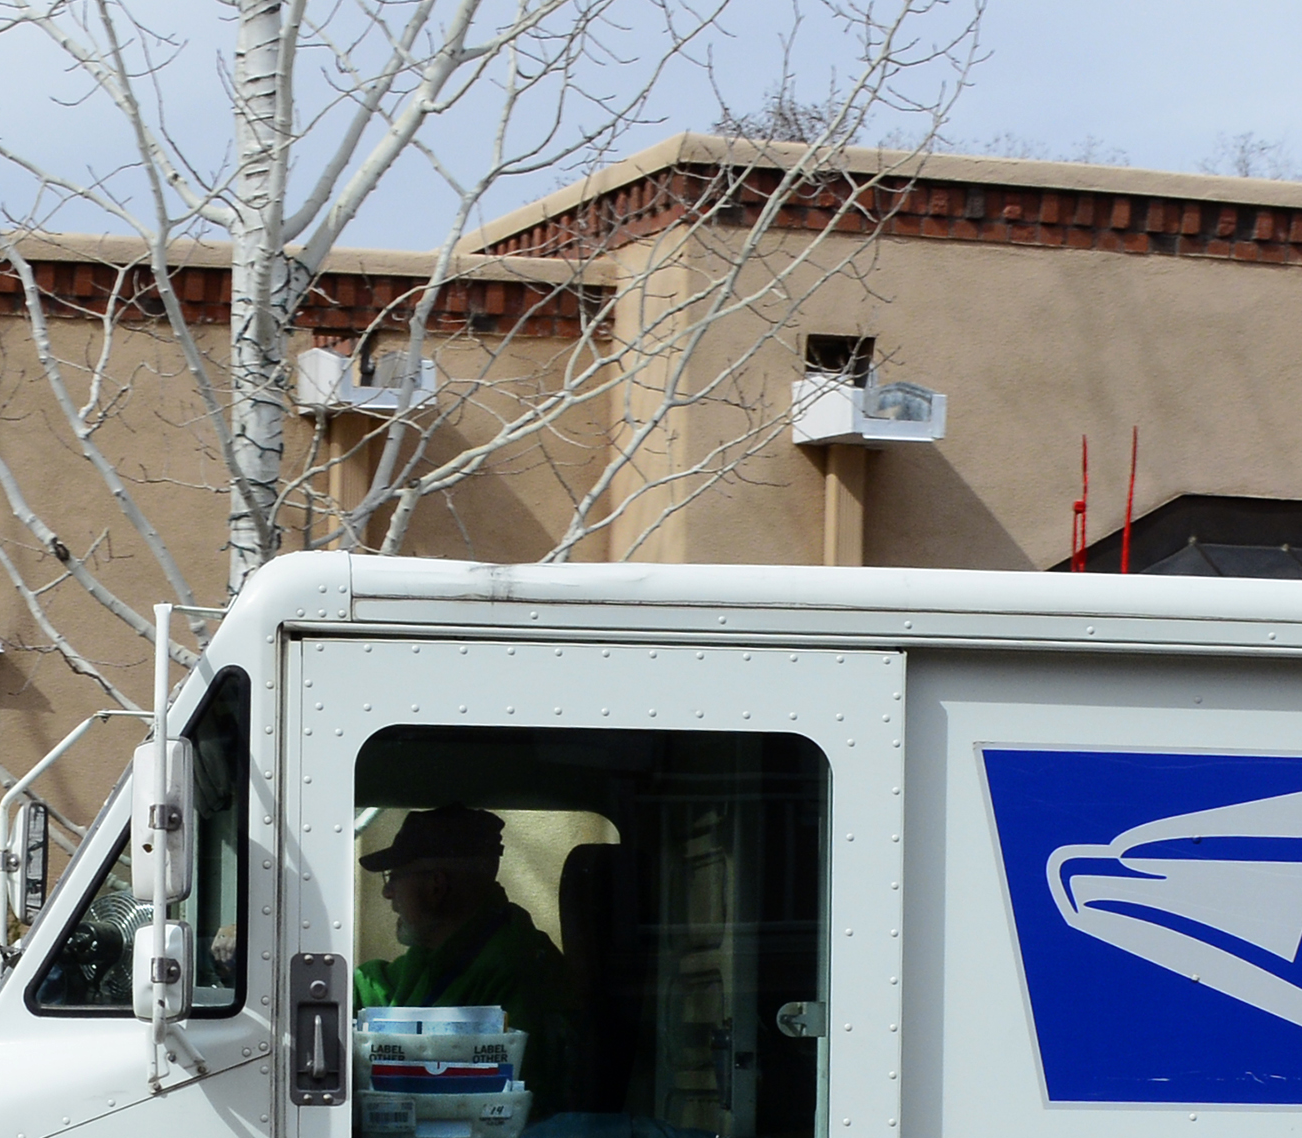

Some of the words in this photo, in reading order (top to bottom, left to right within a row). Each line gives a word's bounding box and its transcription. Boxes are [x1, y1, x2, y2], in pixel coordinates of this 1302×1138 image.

[370, 1044, 405, 1054] LABEL
[474, 1044, 508, 1054] LABEL
[472, 1054, 508, 1063] OTHER
